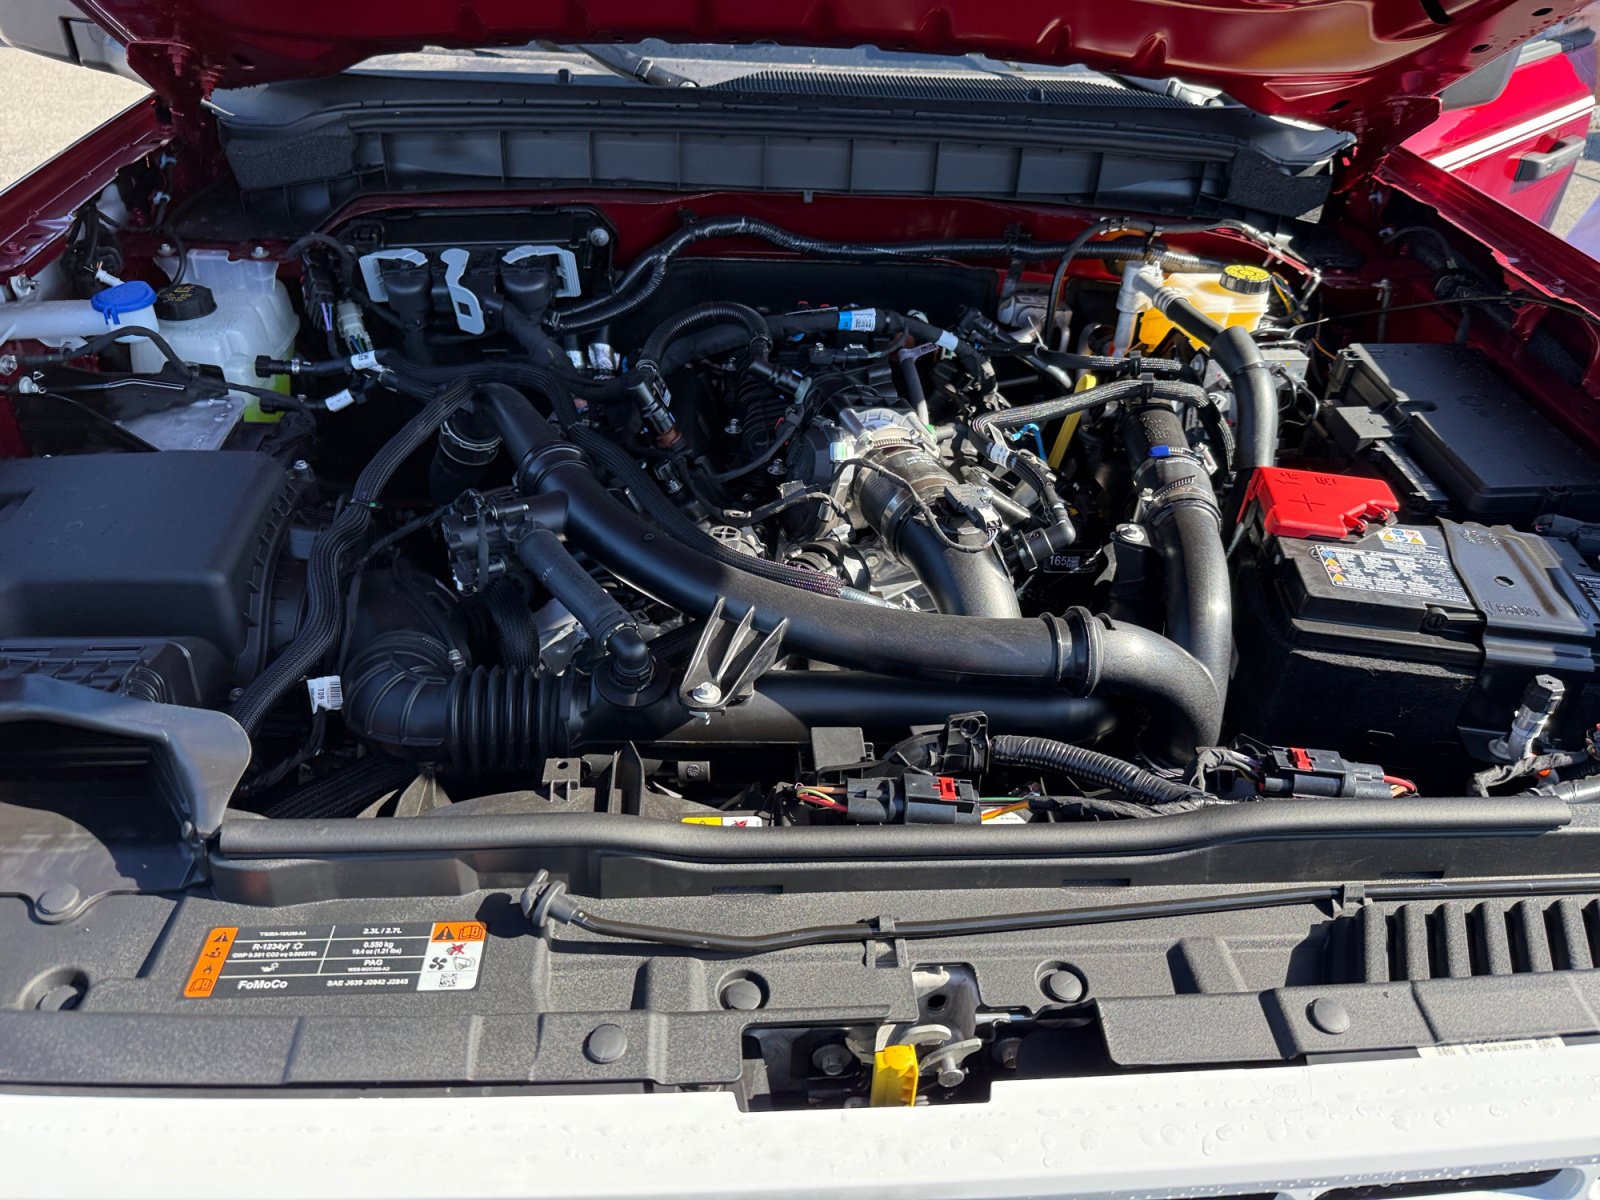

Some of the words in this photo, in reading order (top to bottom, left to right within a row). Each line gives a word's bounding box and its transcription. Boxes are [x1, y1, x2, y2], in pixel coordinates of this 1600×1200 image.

[1049, 555, 1067, 566] 165
[362, 927, 380, 935] 2.3L
[252, 942, 291, 951] R-1234yf
[363, 941, 383, 949] 0.550
[383, 941, 394, 949] kg
[237, 979, 288, 990] FoMoCo
